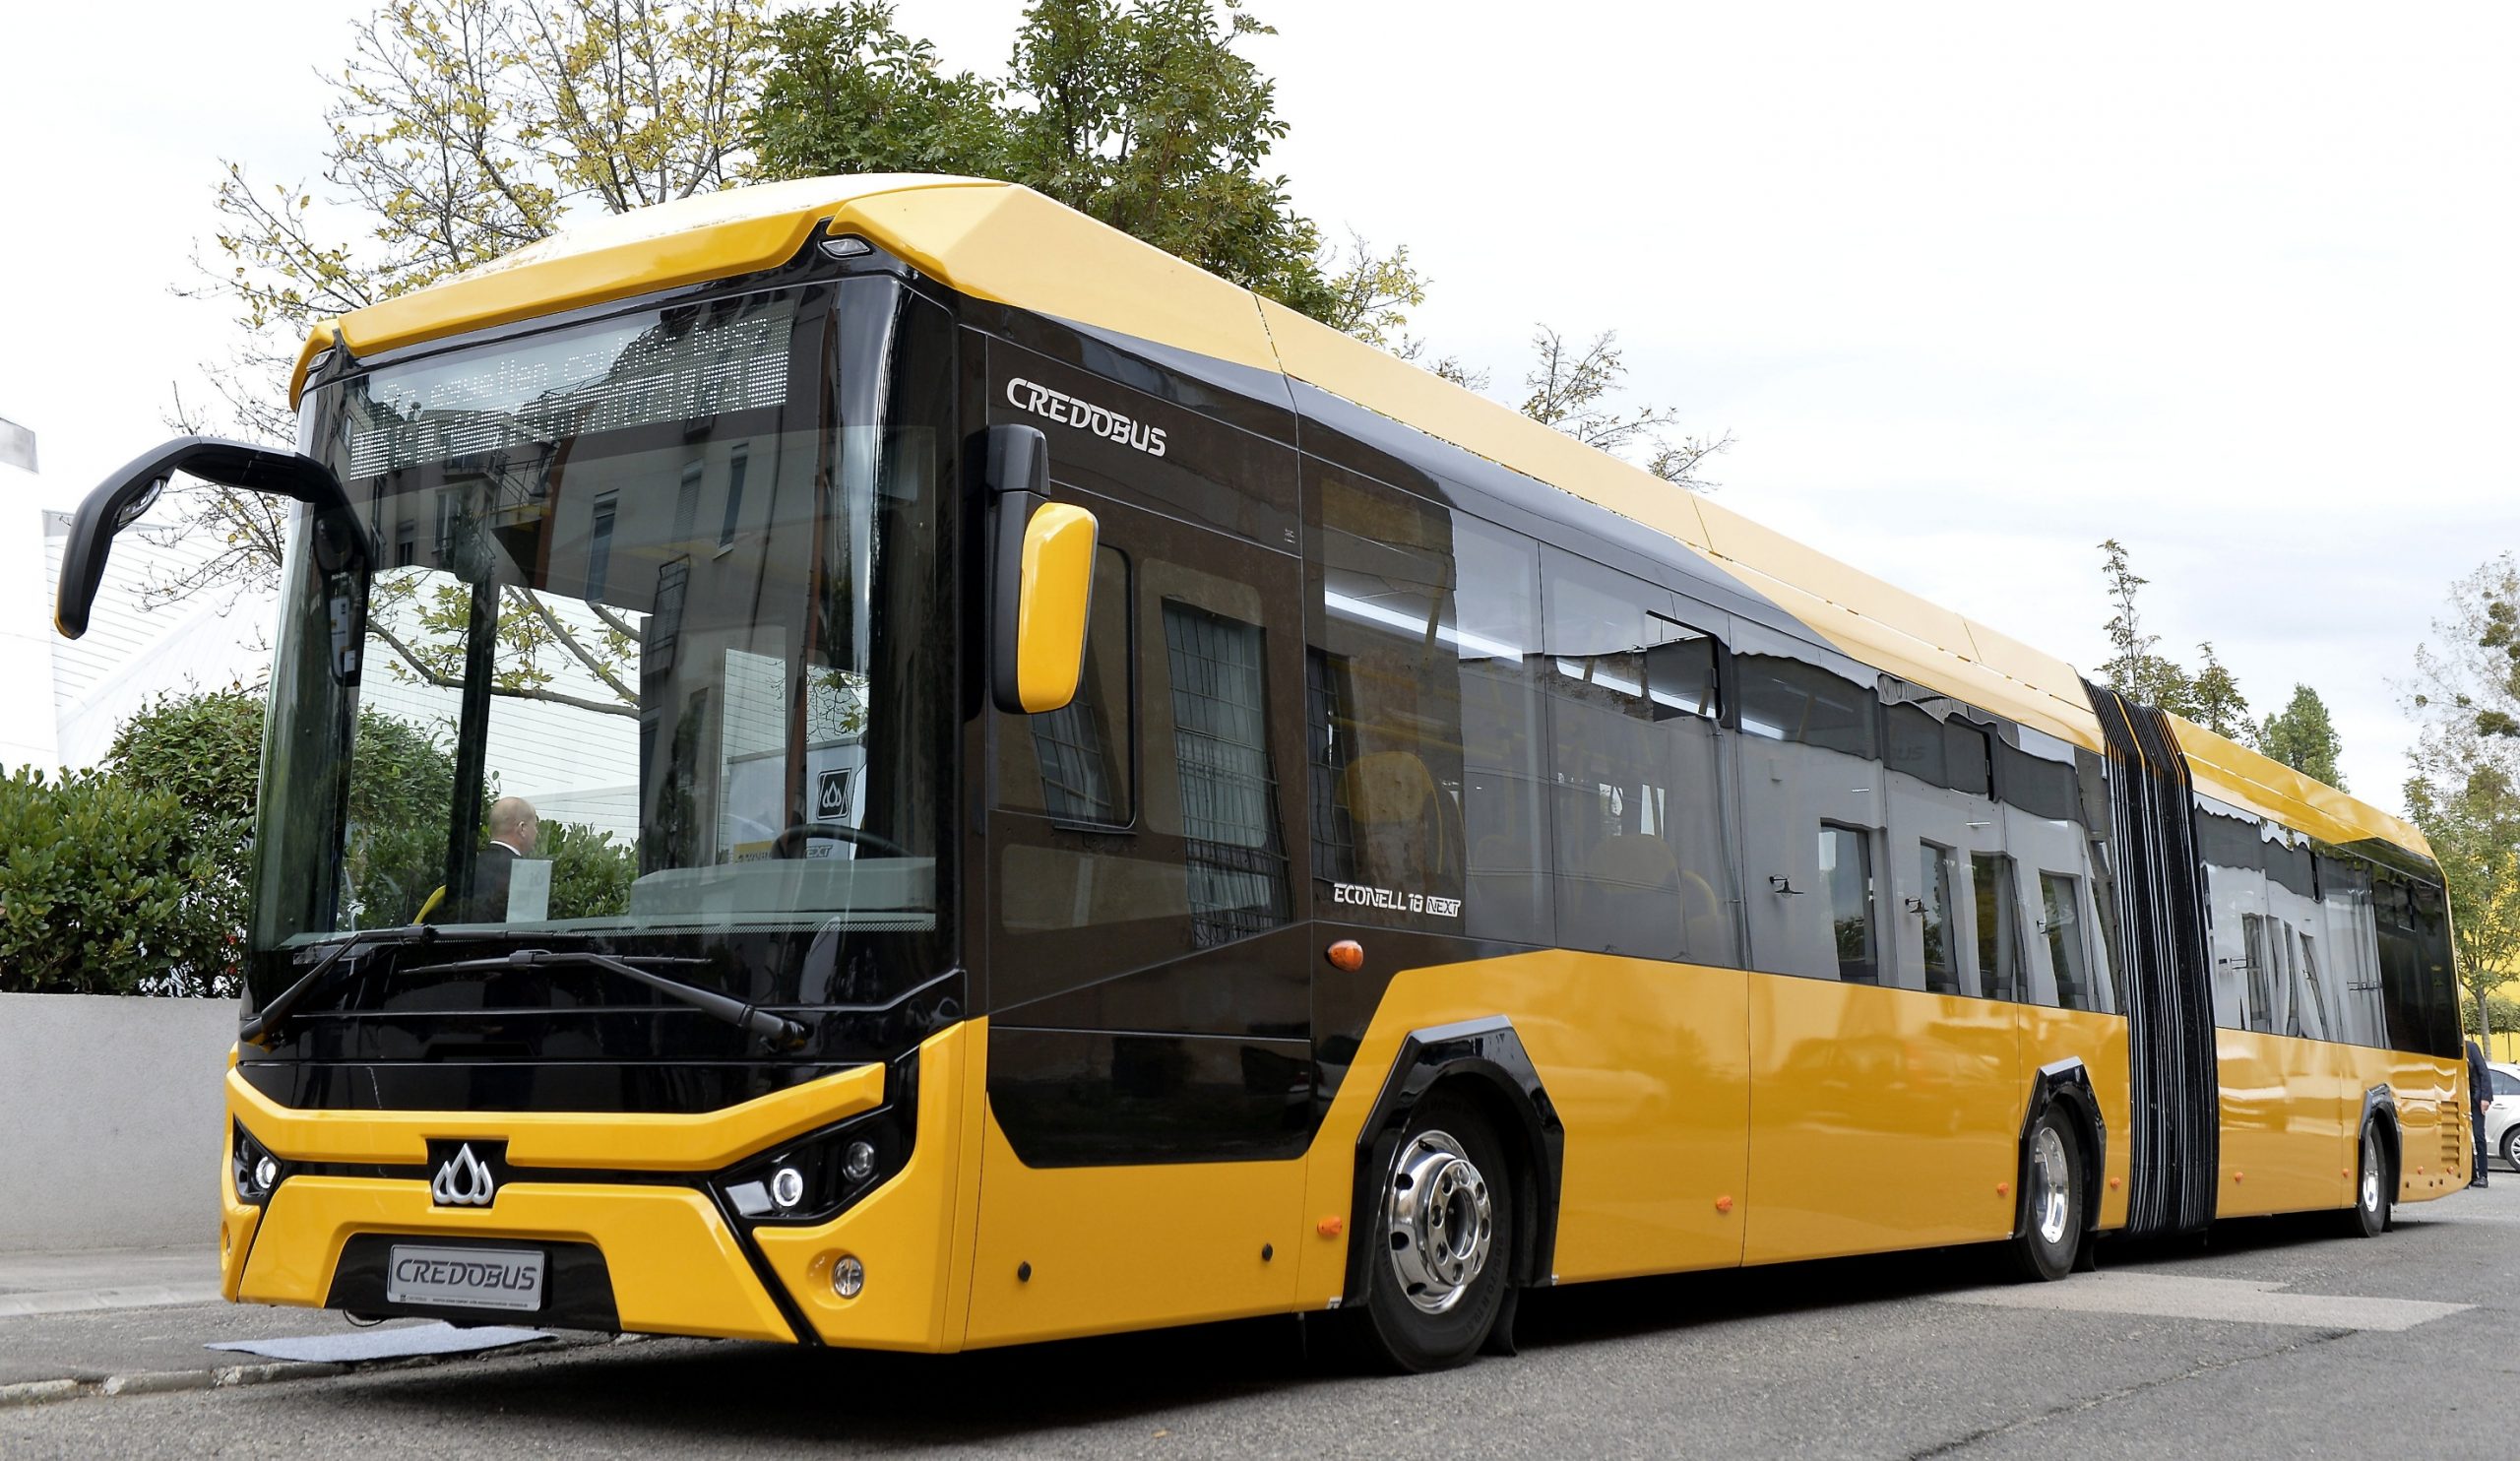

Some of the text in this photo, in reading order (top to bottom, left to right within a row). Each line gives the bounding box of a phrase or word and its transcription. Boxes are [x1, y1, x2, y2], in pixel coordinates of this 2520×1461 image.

[692, 317, 768, 357] busz
[1007, 377, 1167, 458] CREDOBUS
[1334, 883, 1461, 918] ECONELL 18 NEXT
[397, 1259, 537, 1291] CREDOBUS
